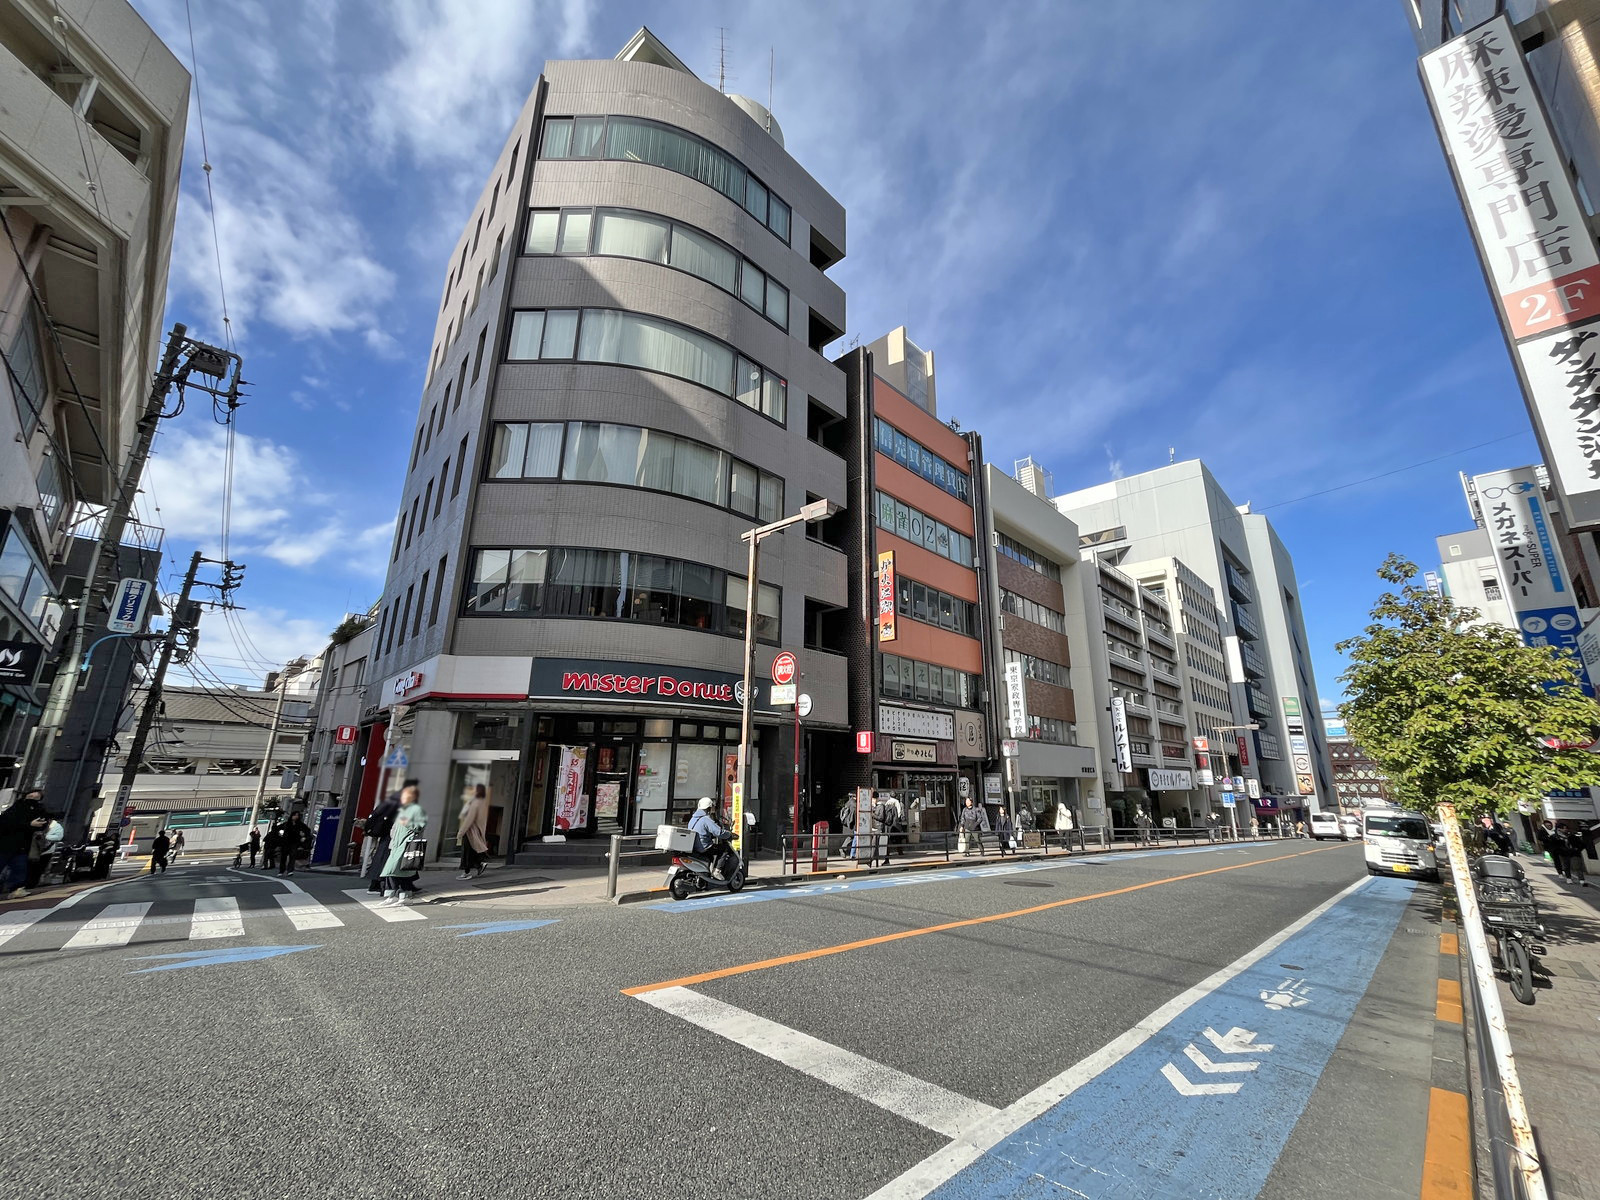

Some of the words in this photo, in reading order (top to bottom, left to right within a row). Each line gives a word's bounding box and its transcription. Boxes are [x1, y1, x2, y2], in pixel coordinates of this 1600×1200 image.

[1520, 278, 1591, 327] 2F
[1492, 501, 1533, 597] メガネスーパー
